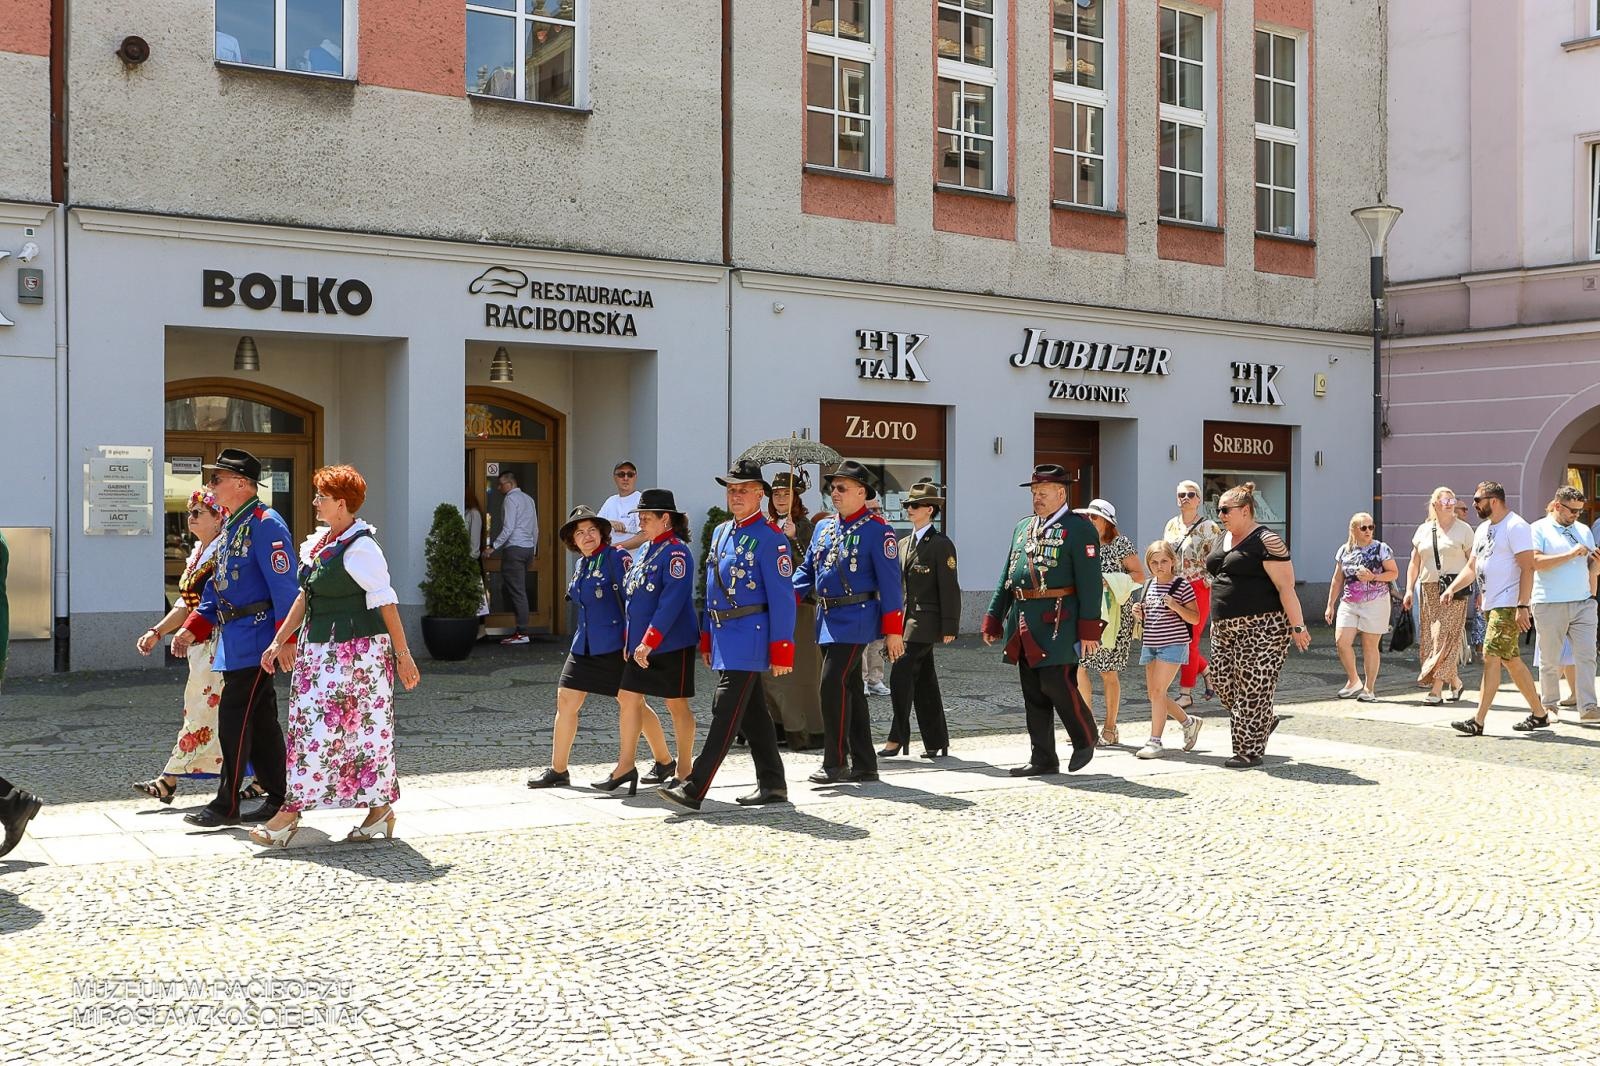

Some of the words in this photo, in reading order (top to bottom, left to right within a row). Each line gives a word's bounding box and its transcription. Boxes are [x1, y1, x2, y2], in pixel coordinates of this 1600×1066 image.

[202, 269, 373, 316] BOLKO
[530, 280, 654, 308] RESTAURACJA
[484, 302, 638, 337] RACIBORSKA
[1009, 327, 1173, 376] JUBILER
[1048, 379, 1130, 404] ZŁOTNIK
[844, 415, 918, 441] ZŁOTO
[1212, 433, 1275, 456] SREBRO
